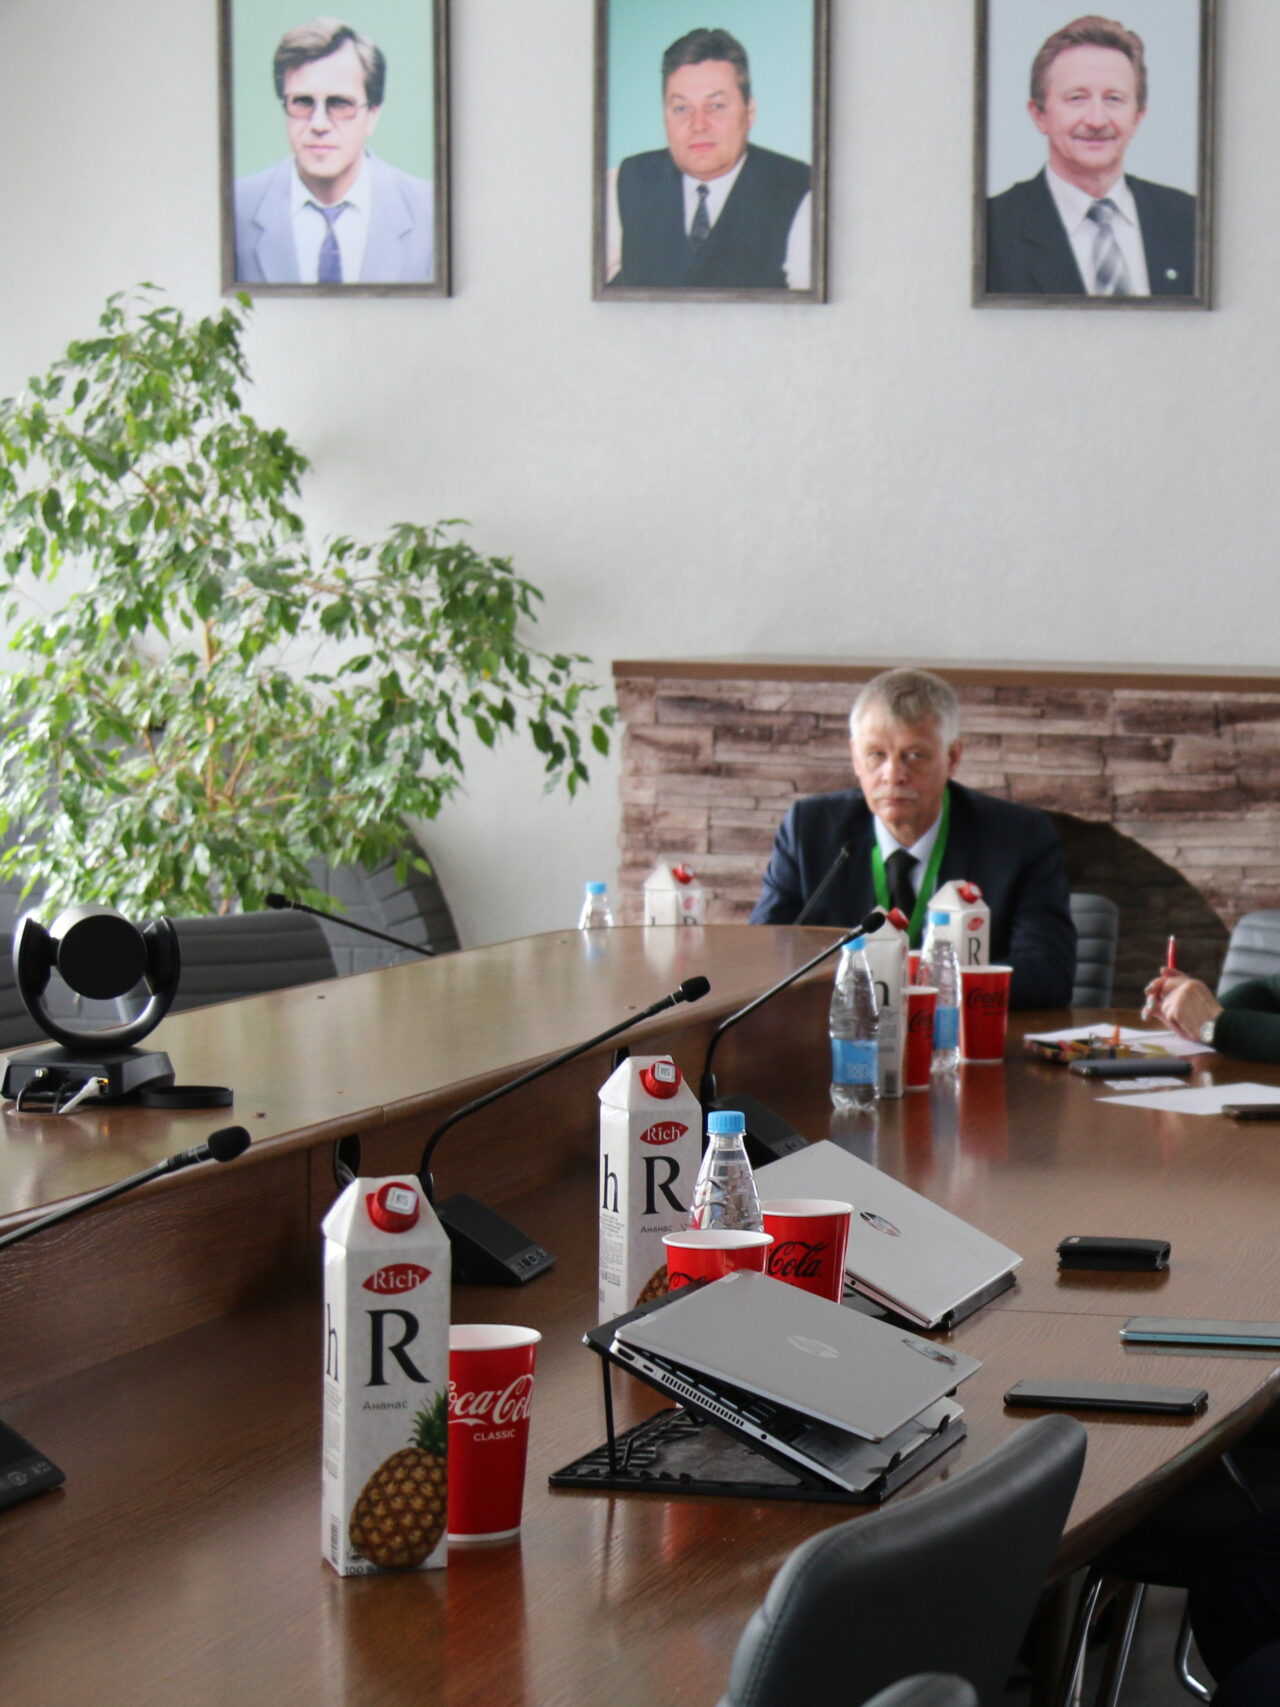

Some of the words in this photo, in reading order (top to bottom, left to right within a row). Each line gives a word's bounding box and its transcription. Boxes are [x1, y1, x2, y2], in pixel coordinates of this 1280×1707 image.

[647, 1125, 680, 1141] Rich
[602, 1154, 619, 1213] h
[641, 1156, 689, 1215] R
[641, 1225, 673, 1234] Ананас
[373, 1269, 421, 1289] Rich
[364, 1309, 431, 1387] R
[362, 1400, 408, 1411] Ананас
[473, 1428, 517, 1442] CLASSIC
